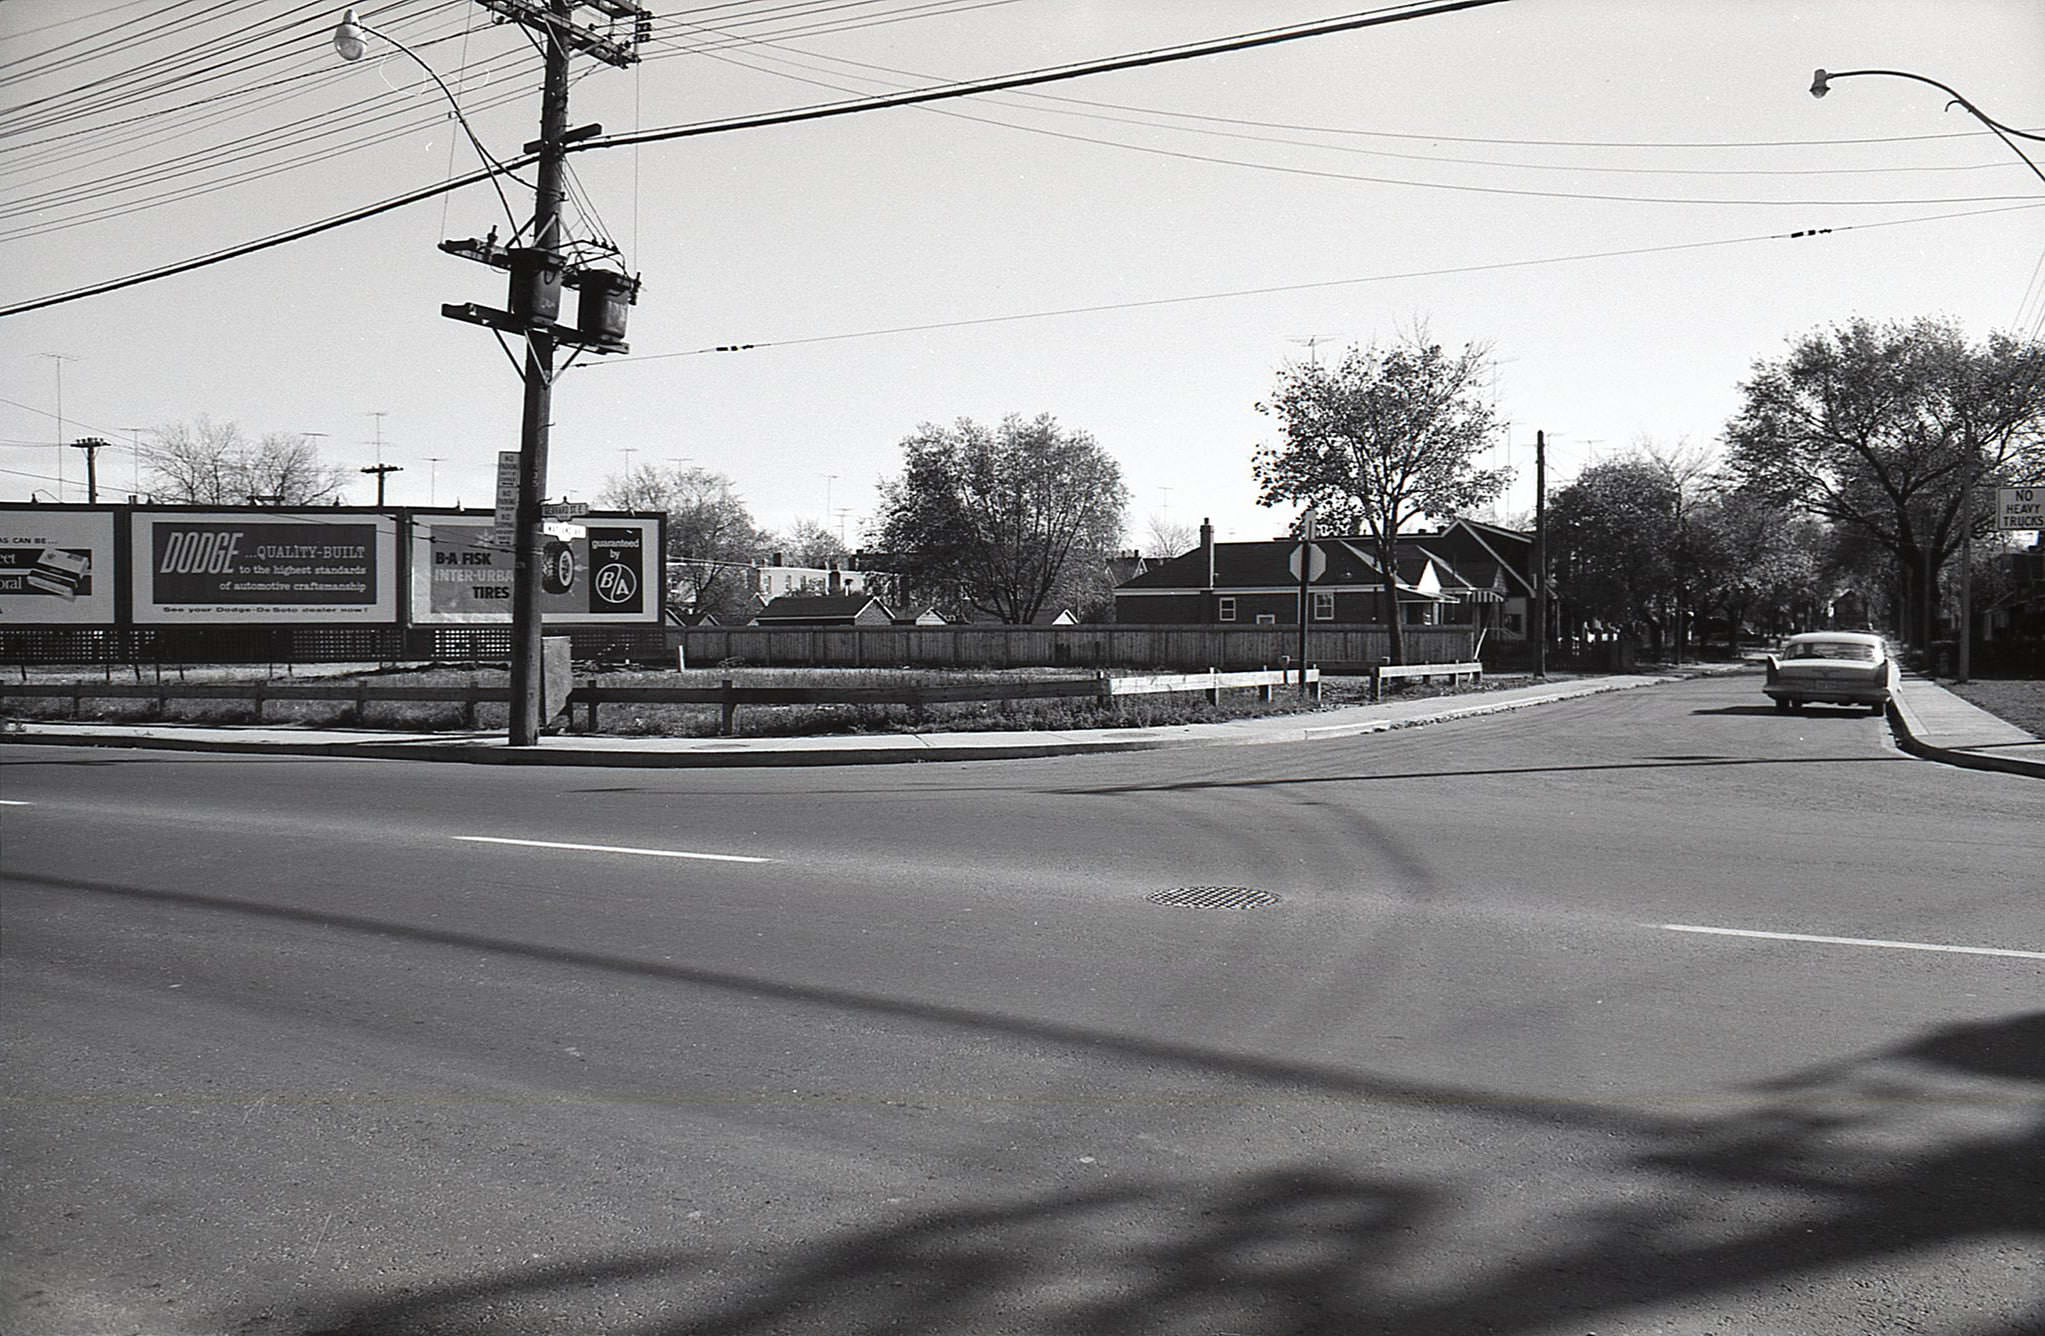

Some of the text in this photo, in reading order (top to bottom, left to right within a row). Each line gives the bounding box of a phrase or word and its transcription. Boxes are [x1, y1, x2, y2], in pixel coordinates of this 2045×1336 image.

[2016, 490, 2033, 501] NO
[2007, 504, 2040, 514] HEAVY
[2004, 516, 2044, 527] TRUCKS
[592, 539, 639, 549] guaranteed
[160, 532, 244, 574] DODGE
[462, 552, 492, 565] FISK
[609, 549, 620, 560] by
[239, 565, 366, 576] to the highest standards
[434, 569, 514, 582] INTER-URBA
[219, 581, 366, 592] of automotive craftsmanship
[472, 586, 510, 599] TIRES
